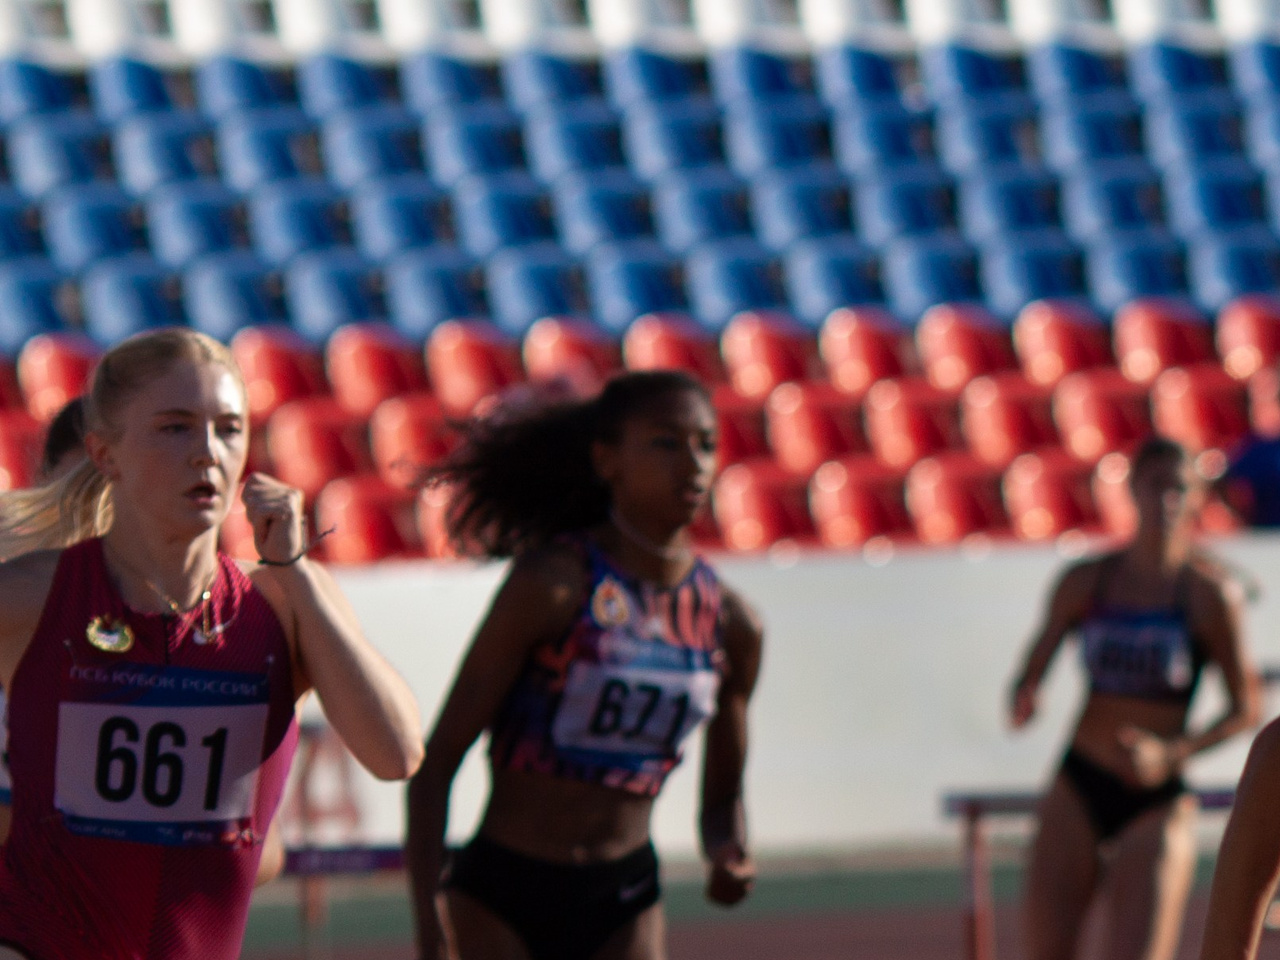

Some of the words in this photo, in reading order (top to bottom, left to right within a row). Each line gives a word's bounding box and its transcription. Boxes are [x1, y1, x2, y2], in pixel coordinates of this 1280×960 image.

[181, 677, 258, 696] РОССИИ
[590, 679, 690, 753] 671
[95, 716, 228, 811] 661
